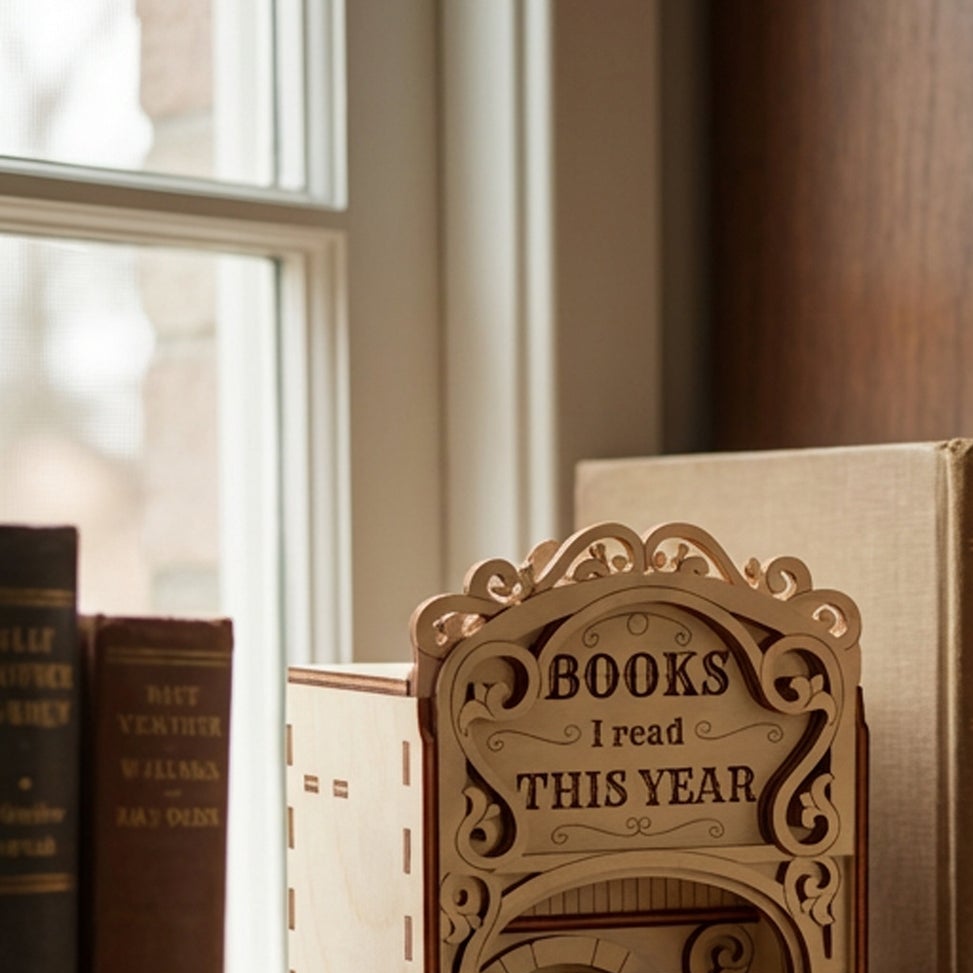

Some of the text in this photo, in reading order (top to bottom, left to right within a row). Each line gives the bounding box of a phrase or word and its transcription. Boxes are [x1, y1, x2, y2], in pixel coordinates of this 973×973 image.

[545, 650, 731, 700] BOOKS
[591, 717, 684, 748] I read
[517, 765, 757, 810] THIS YEAR
